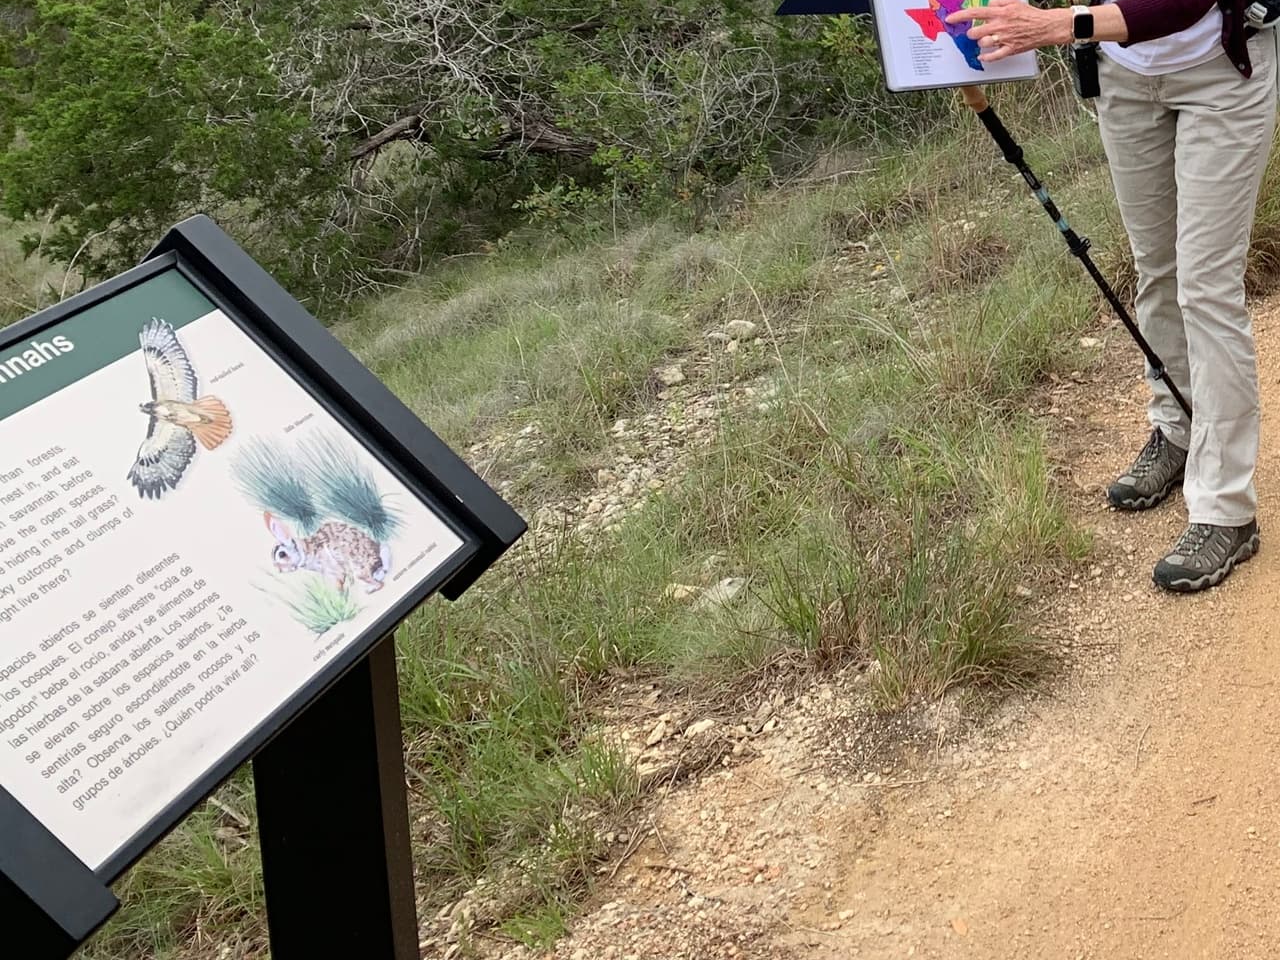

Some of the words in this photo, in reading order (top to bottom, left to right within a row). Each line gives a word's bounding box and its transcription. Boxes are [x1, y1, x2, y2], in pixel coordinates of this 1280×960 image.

[0, 487, 25, 506] nest
[25, 480, 41, 492] in,
[40, 465, 62, 483] and
[61, 456, 80, 470] eat
[9, 488, 60, 522] savannah
[59, 469, 94, 492] before
[26, 444, 67, 468] forests.
[5, 544, 42, 569] hiding
[40, 537, 52, 549] in
[51, 526, 71, 541] the
[69, 513, 88, 530] tall
[86, 493, 121, 521] grass?
[16, 553, 63, 586] outcrops
[63, 539, 86, 557] and
[86, 516, 122, 542] clumps
[121, 506, 135, 520] of
[17, 524, 38, 539] the
[39, 506, 67, 526] open
[68, 483, 107, 510] spaces.
[0, 686, 21, 703] los
[19, 654, 70, 689] bosques.
[67, 640, 84, 655] El
[82, 619, 117, 646] conejo
[116, 591, 157, 622] silvestre
[179, 565, 194, 578] de
[16, 591, 40, 608] live
[37, 568, 72, 595] there?
[38, 620, 81, 652] abiertos
[82, 609, 97, 622] se
[98, 583, 135, 611] sienten
[135, 552, 181, 585] diferentes
[7, 732, 30, 750] las
[24, 704, 69, 737] hierbas
[65, 692, 83, 708] de
[79, 684, 95, 697] la
[92, 658, 131, 688] sabana
[128, 633, 166, 662] abierta.
[161, 619, 183, 637] Los
[179, 591, 222, 623] halcones
[24, 749, 42, 765] se
[43, 720, 81, 750] elevan
[81, 696, 113, 721] sobre
[111, 681, 132, 698] los
[131, 649, 175, 683] espacios
[174, 620, 216, 651] abiertos.
[217, 602, 234, 623] ¿Te
[39, 678, 70, 701] bebe
[68, 667, 81, 681] el
[107, 629, 138, 653] anida
[135, 623, 146, 634] y
[143, 614, 158, 627] se
[155, 587, 196, 618] alimenta
[192, 577, 208, 591] de
[40, 741, 88, 780] sentirías
[87, 712, 125, 743] seguro
[192, 648, 208, 662] en
[204, 638, 220, 651] la
[216, 617, 249, 641] hierba
[56, 767, 84, 795] alta?
[85, 732, 133, 770] Observa
[131, 716, 152, 733] los
[153, 681, 196, 718] salientes
[197, 651, 234, 683] rocosos
[234, 643, 245, 655] y
[243, 629, 262, 645] los
[71, 776, 111, 812] grupos
[107, 764, 125, 781] de
[121, 735, 164, 770] árboles.
[193, 683, 226, 713] podría
[221, 669, 242, 688] vivir
